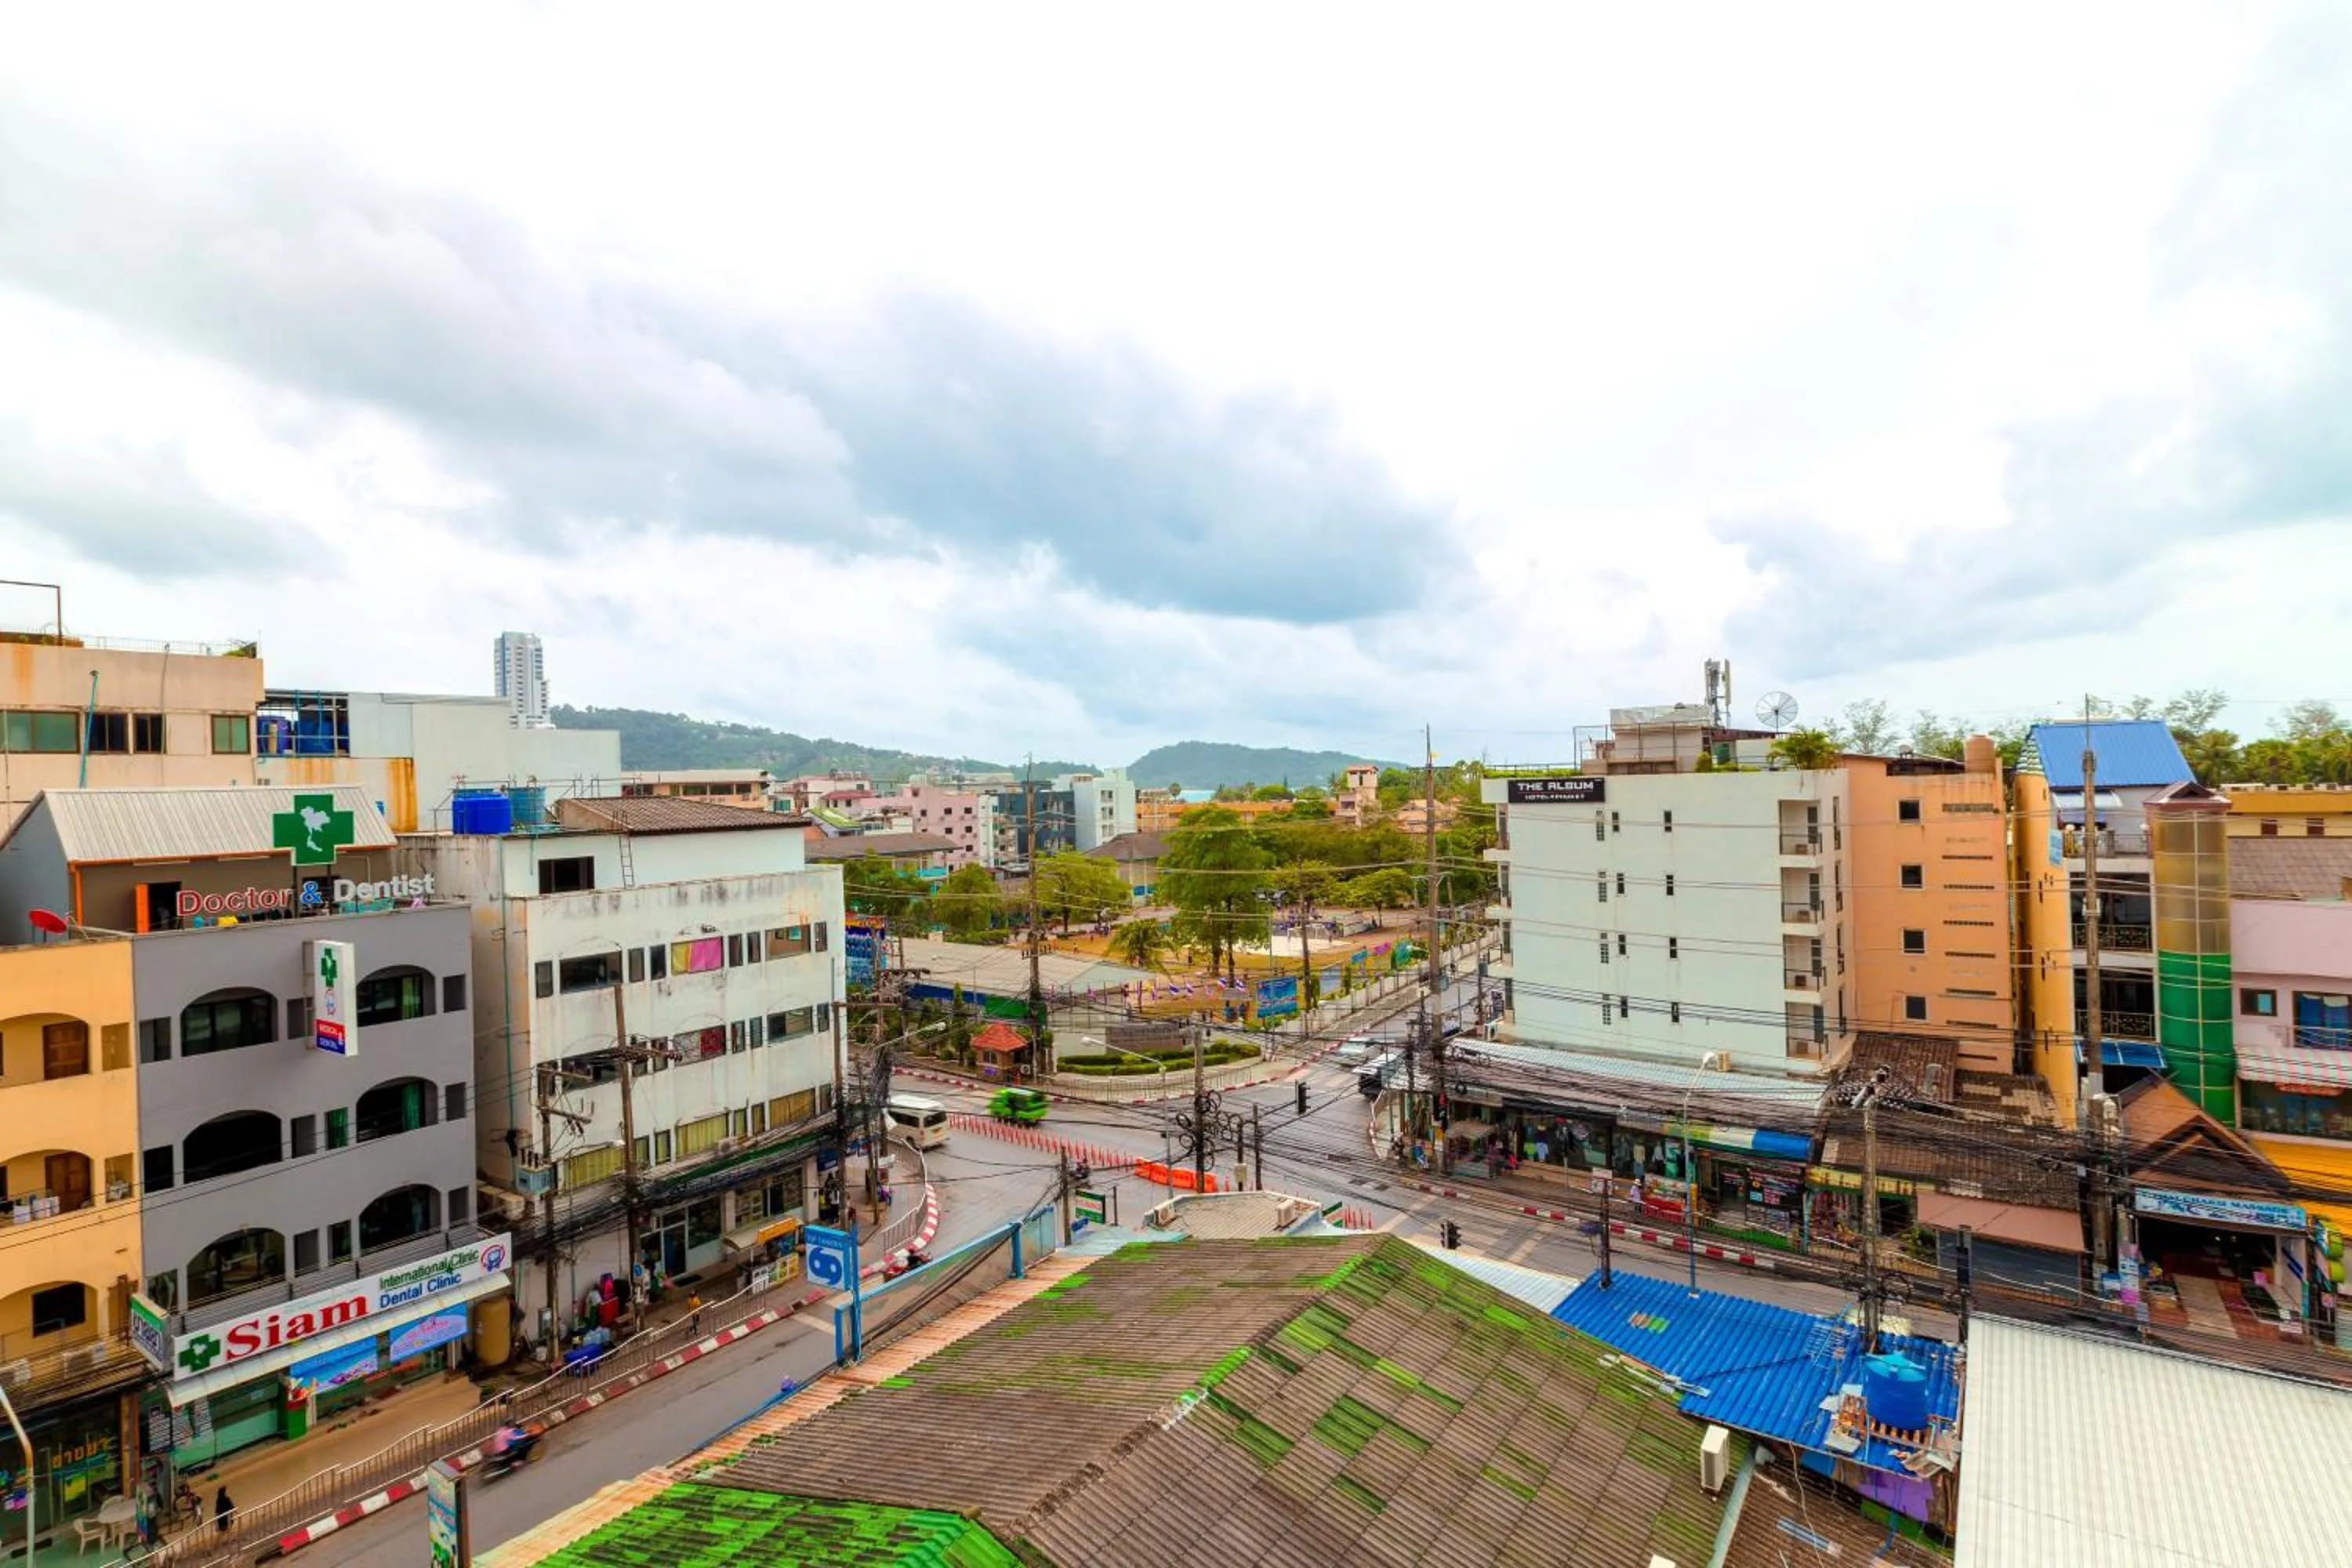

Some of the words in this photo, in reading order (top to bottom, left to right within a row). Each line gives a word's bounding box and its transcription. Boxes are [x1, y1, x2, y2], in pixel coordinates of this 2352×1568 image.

[1518, 782, 1544, 790] THE
[176, 887, 293, 916] Doctor
[301, 881, 323, 904] &
[334, 873, 434, 902] Dentist
[379, 1258, 448, 1290] International
[450, 1249, 480, 1268] Clinic
[379, 1283, 423, 1308] Dental
[427, 1272, 463, 1293] Clinic
[225, 1294, 369, 1361] Siam
